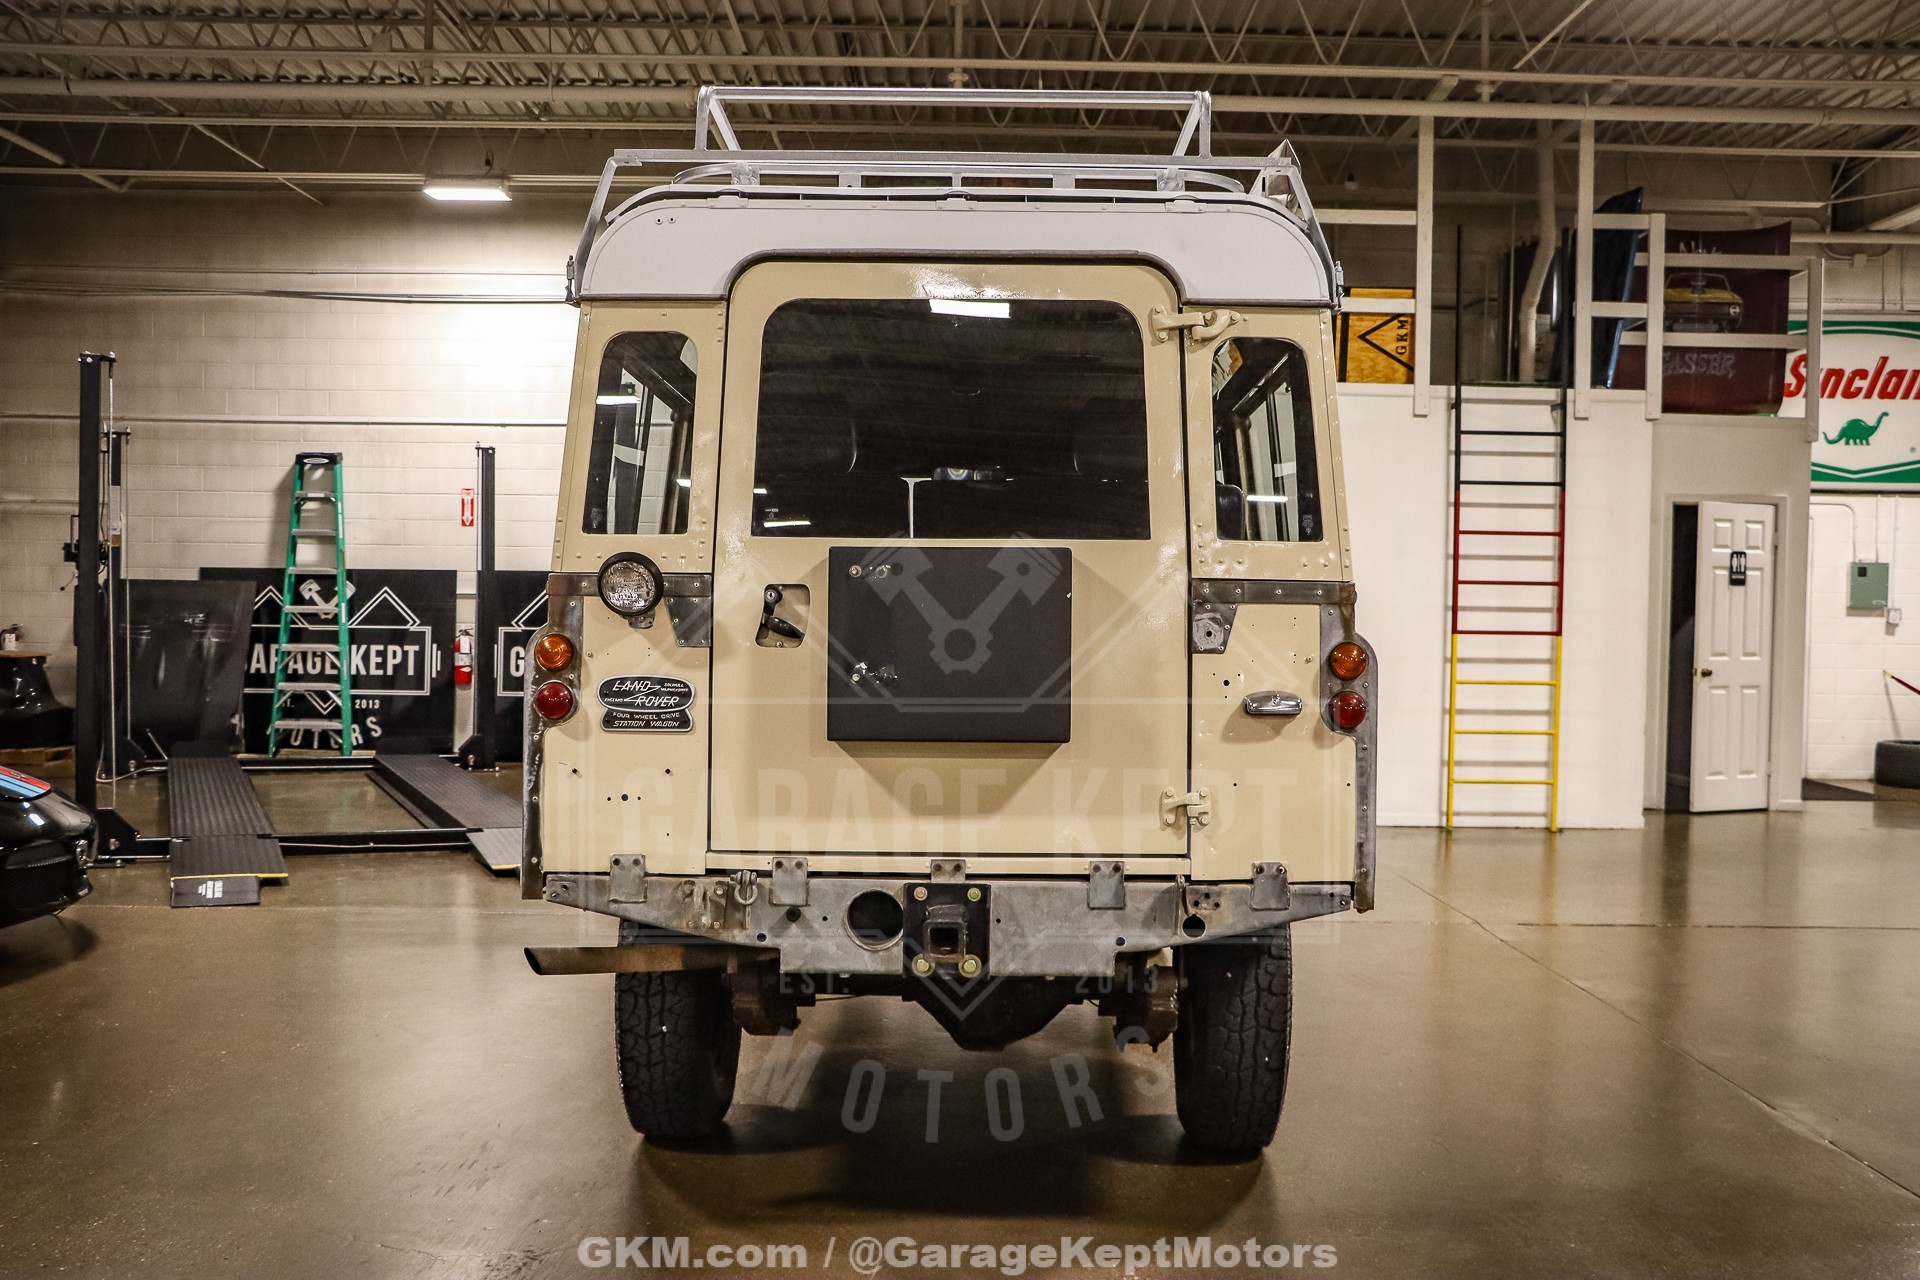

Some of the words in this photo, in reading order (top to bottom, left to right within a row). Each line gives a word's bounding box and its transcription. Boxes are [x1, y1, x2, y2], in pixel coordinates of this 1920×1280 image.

[1395, 319, 1409, 355] GKM
[1784, 353, 1920, 400] Snclai
[350, 644, 420, 676] KEPT
[612, 680, 651, 691] LAND
[355, 699, 380, 709] 2013
[635, 696, 679, 707] ROVER
